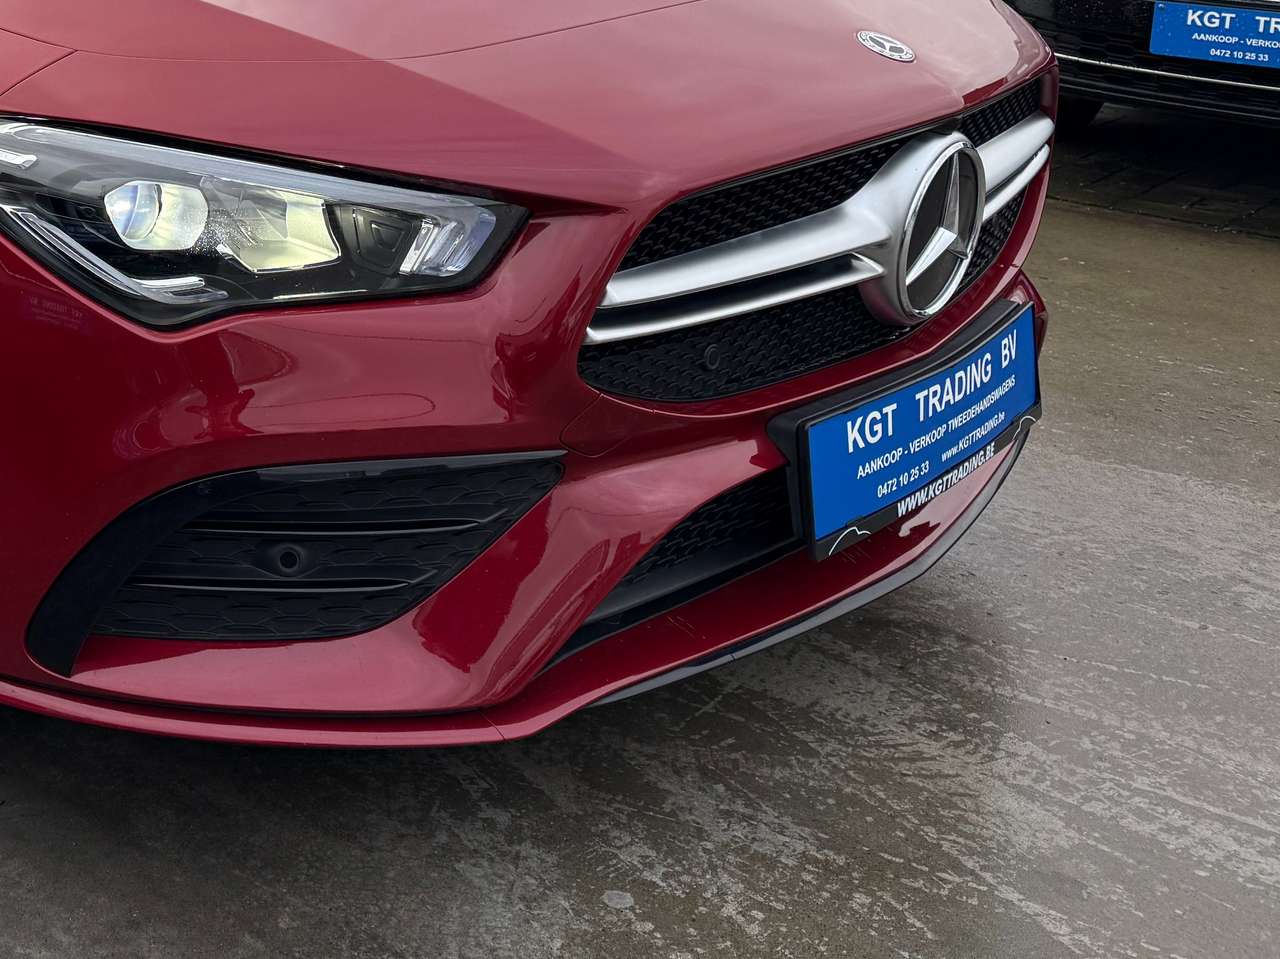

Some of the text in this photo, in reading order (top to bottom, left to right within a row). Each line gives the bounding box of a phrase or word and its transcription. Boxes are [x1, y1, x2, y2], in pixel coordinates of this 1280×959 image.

[1186, 9, 1236, 29] KGT
[1192, 33, 1239, 44] AANKOOP
[1245, 38, 1280, 48] VERKO
[1210, 48, 1269, 61] 0472 10 25 33
[846, 329, 1017, 453] KGT TRADING BV
[857, 448, 903, 479] AANKOOP
[909, 424, 947, 454] VERKOOP
[948, 374, 1016, 433] TWEEDEHANDSWAGENS
[877, 411, 1005, 498] 0472 10 25 33 www.KGTTRADING.be
[897, 443, 996, 518] WWW.KGTTRADING.BE
